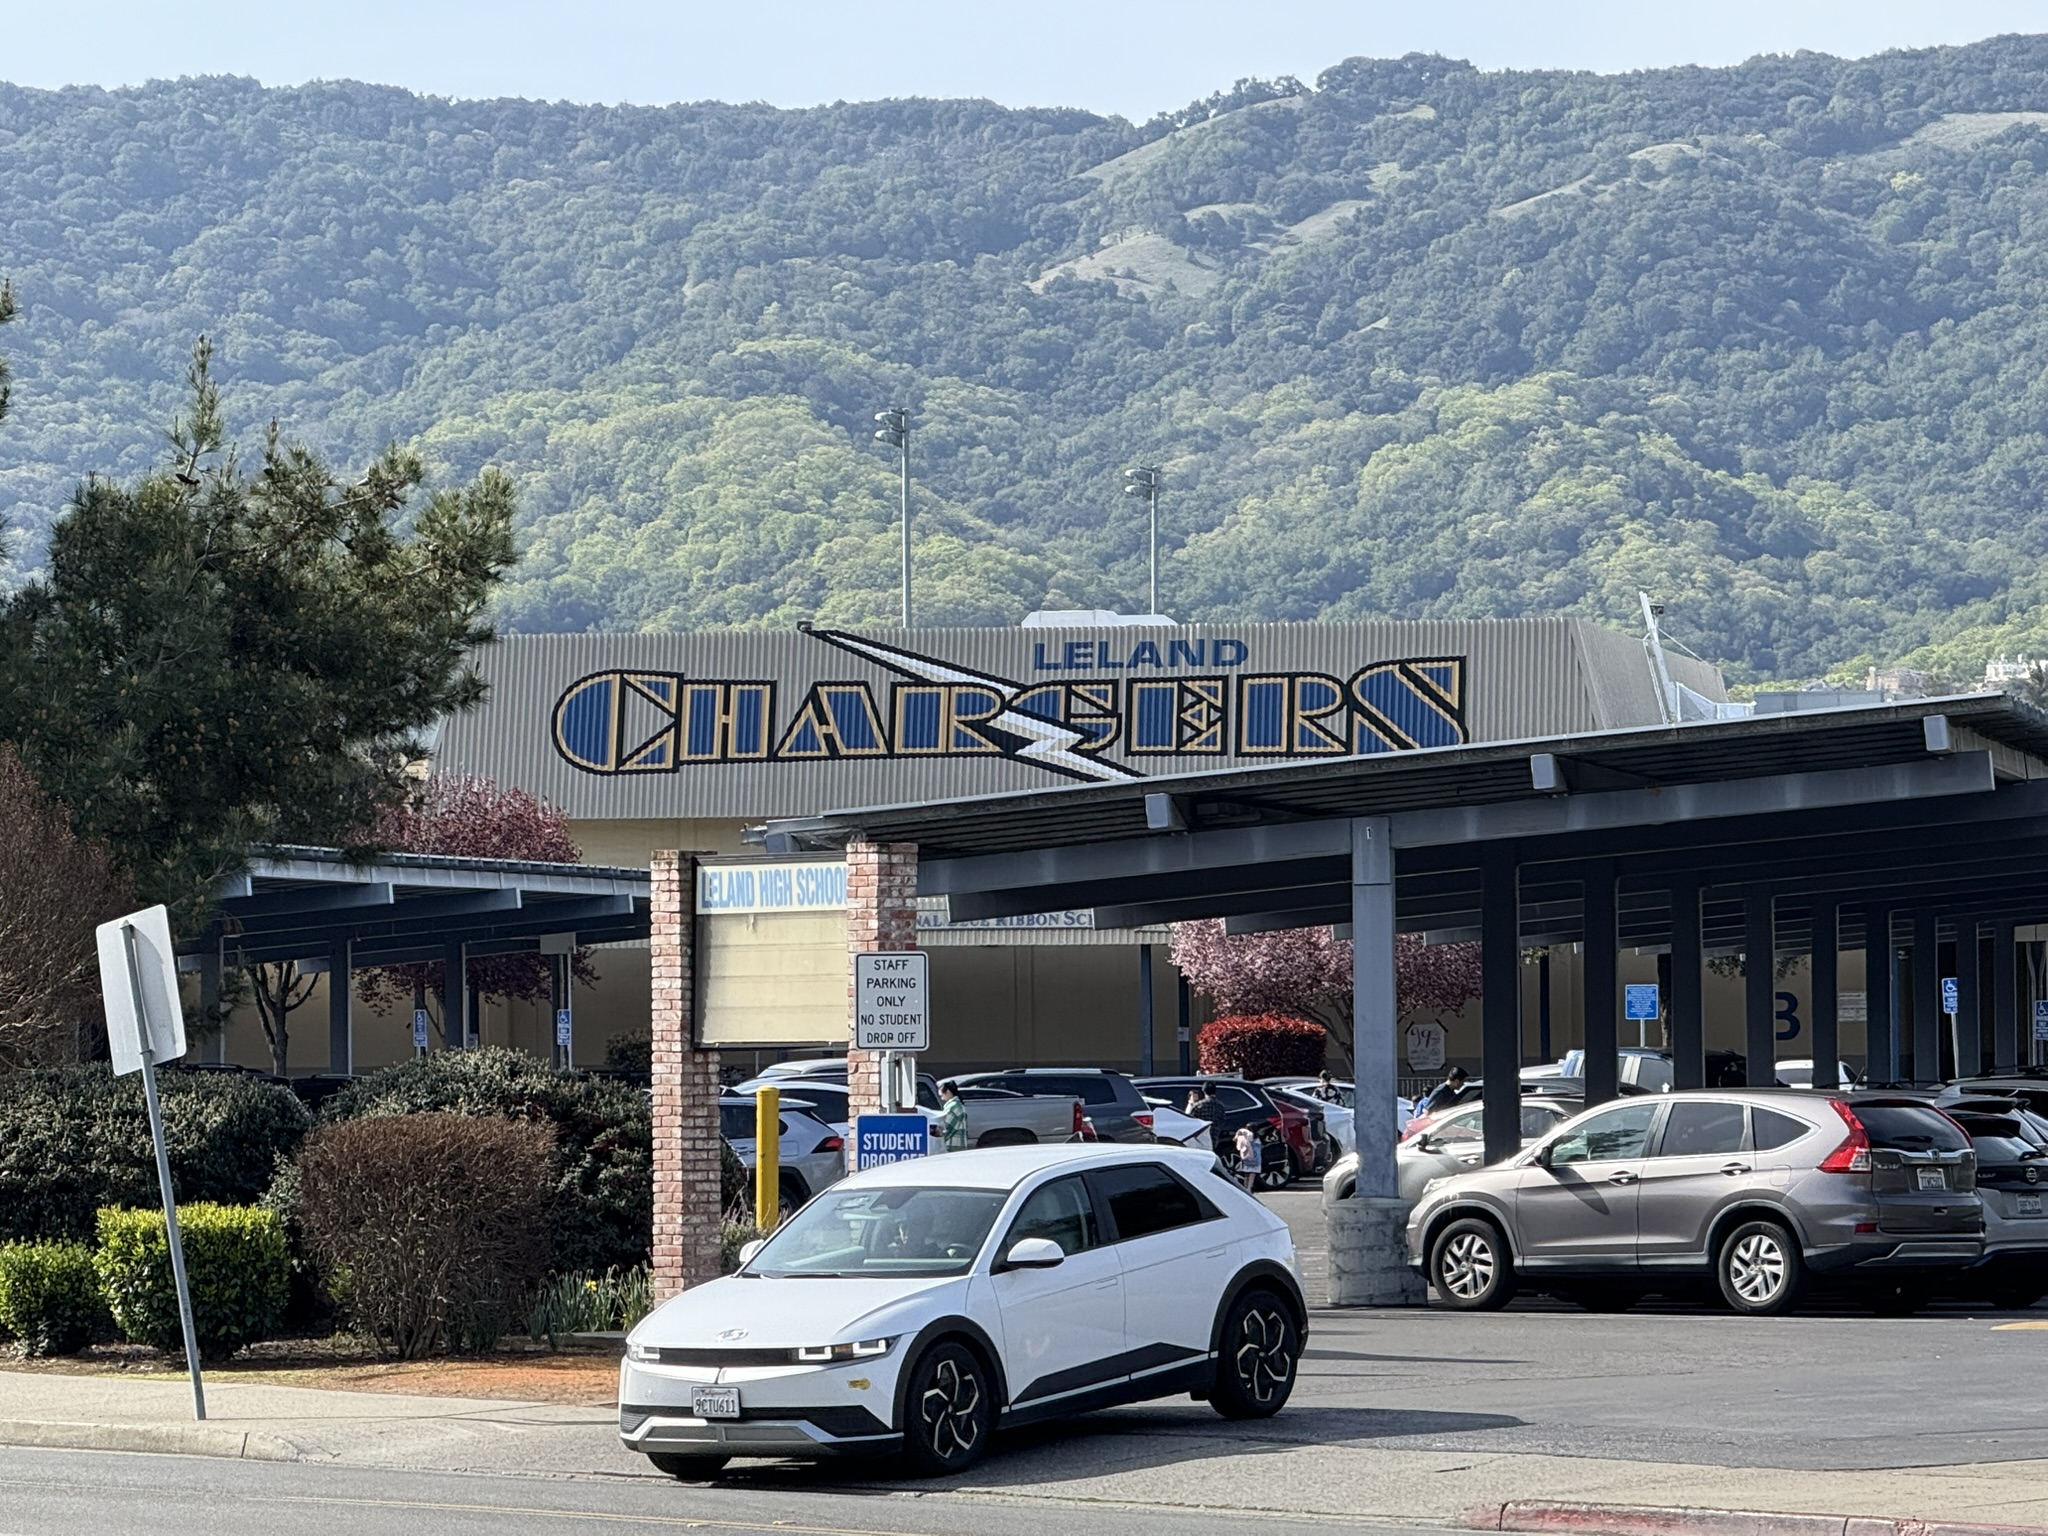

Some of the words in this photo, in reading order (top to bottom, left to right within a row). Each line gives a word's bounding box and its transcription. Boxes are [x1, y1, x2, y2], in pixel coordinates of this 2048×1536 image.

[1034, 638, 1249, 671] LELAND
[551, 656, 1469, 776] CHARGERS
[701, 870, 755, 909] LELAND
[758, 868, 793, 907] HIGH
[995, 914, 1060, 926] RIBBON
[874, 959, 909, 971] STAFF
[866, 977, 917, 989] PARKING
[876, 995, 906, 1007] ONLY
[860, 1013, 875, 1025] NO
[879, 1013, 922, 1025] STUDENT
[867, 1032, 894, 1044] DROP
[897, 1031, 917, 1044] OFF
[863, 1133, 923, 1150] STUDENT
[861, 1152, 897, 1170] DROP
[695, 1398, 736, 1413] 9CTU611
